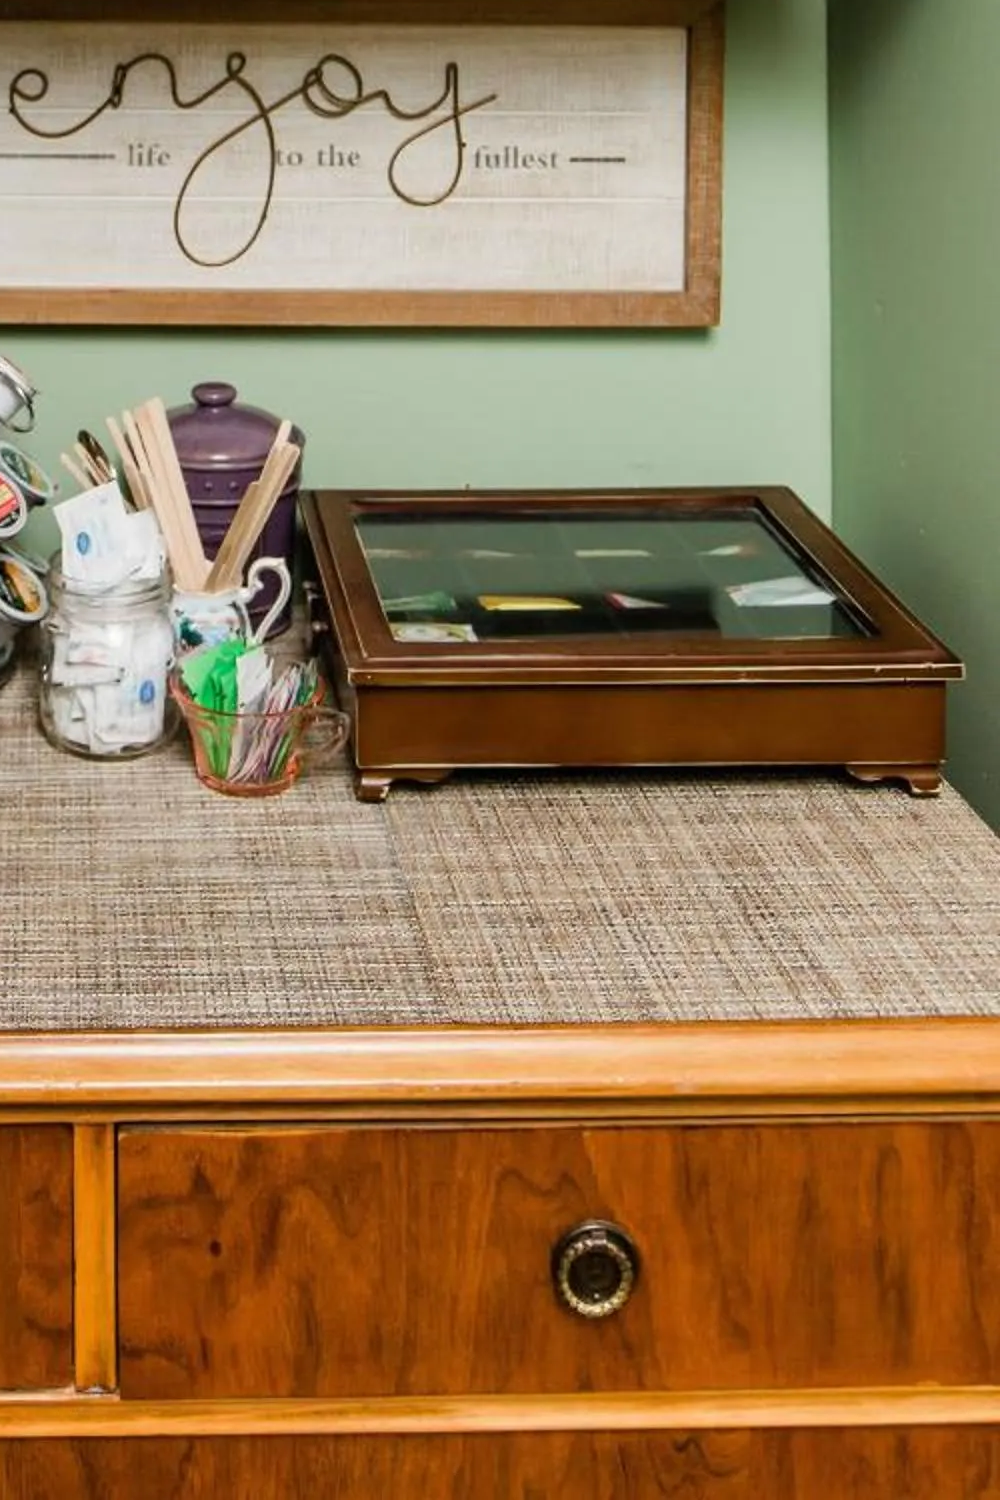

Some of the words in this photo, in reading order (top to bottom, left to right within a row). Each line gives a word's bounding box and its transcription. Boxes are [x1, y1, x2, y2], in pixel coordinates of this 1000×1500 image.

[8, 52, 498, 267] enjoy
[127, 143, 171, 168] life
[275, 148, 303, 167] to
[317, 143, 361, 167] the
[474, 146, 559, 170] fullest
